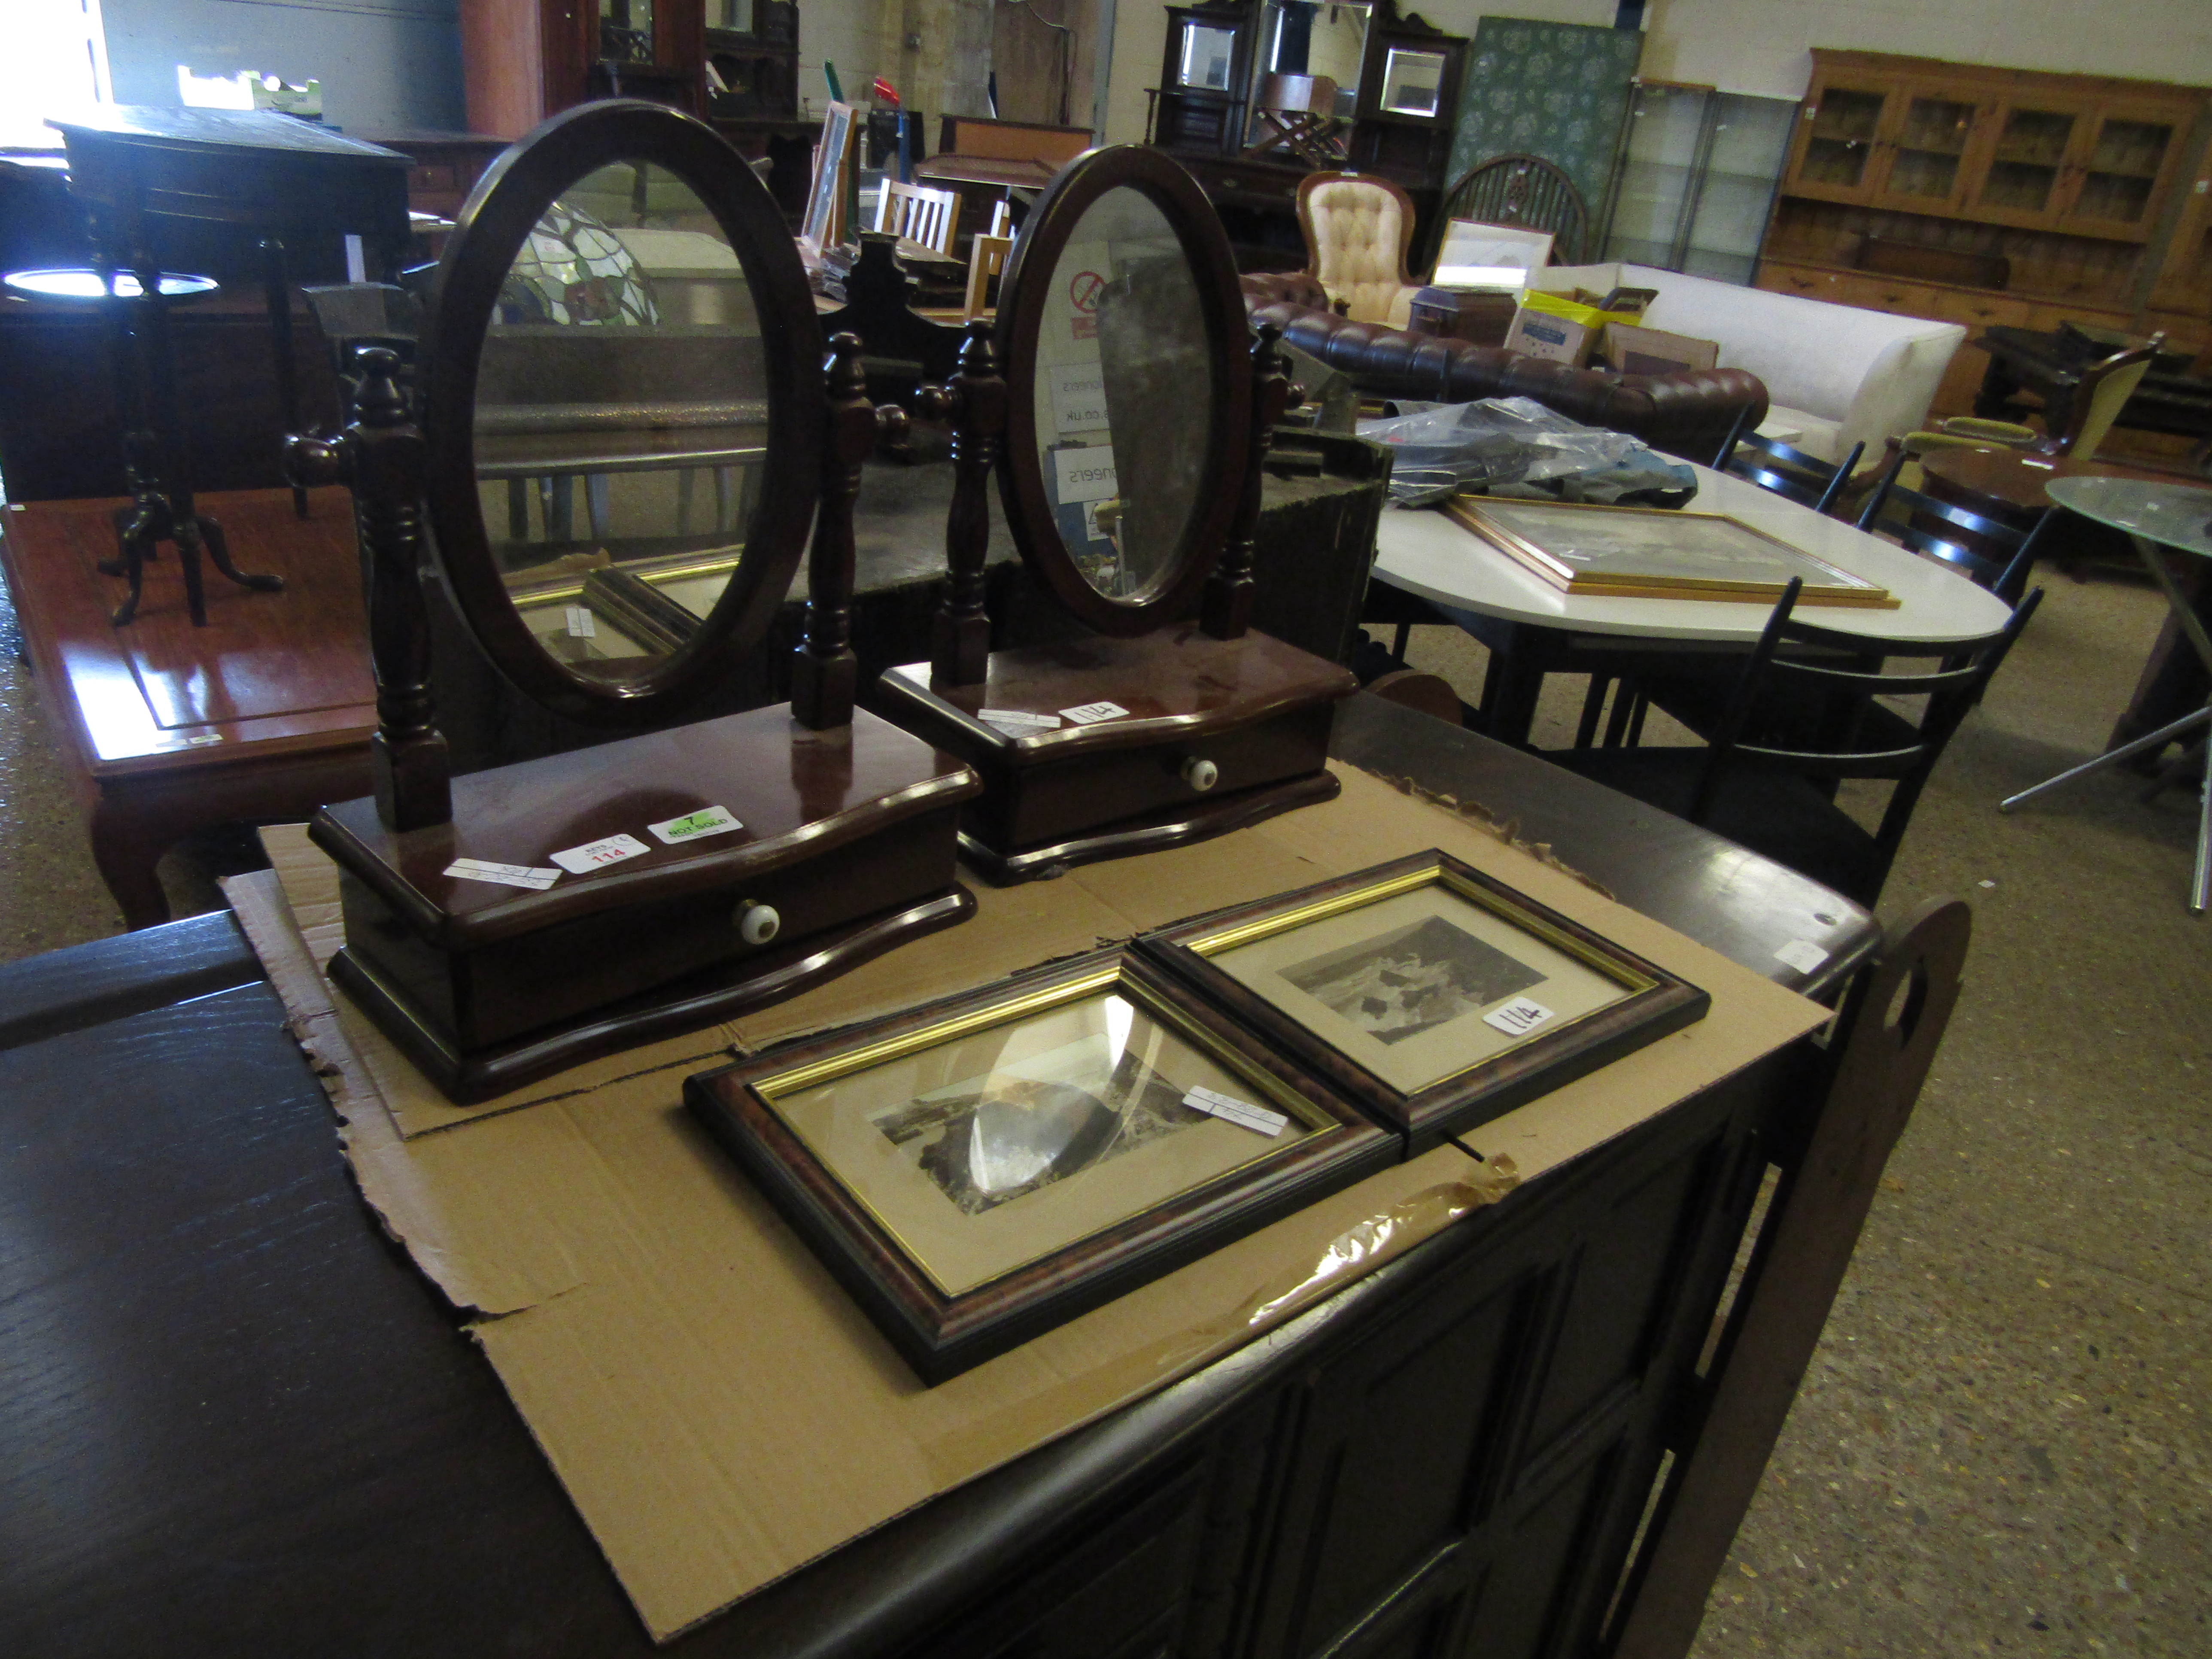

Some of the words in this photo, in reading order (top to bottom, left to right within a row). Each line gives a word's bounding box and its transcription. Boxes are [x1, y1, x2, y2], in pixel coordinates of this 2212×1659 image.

[668, 827, 692, 836] NOT
[695, 818, 729, 830] SOLD
[684, 816, 694, 825] 7
[592, 849, 626, 862] 114
[1498, 1006, 1543, 1029] 114
